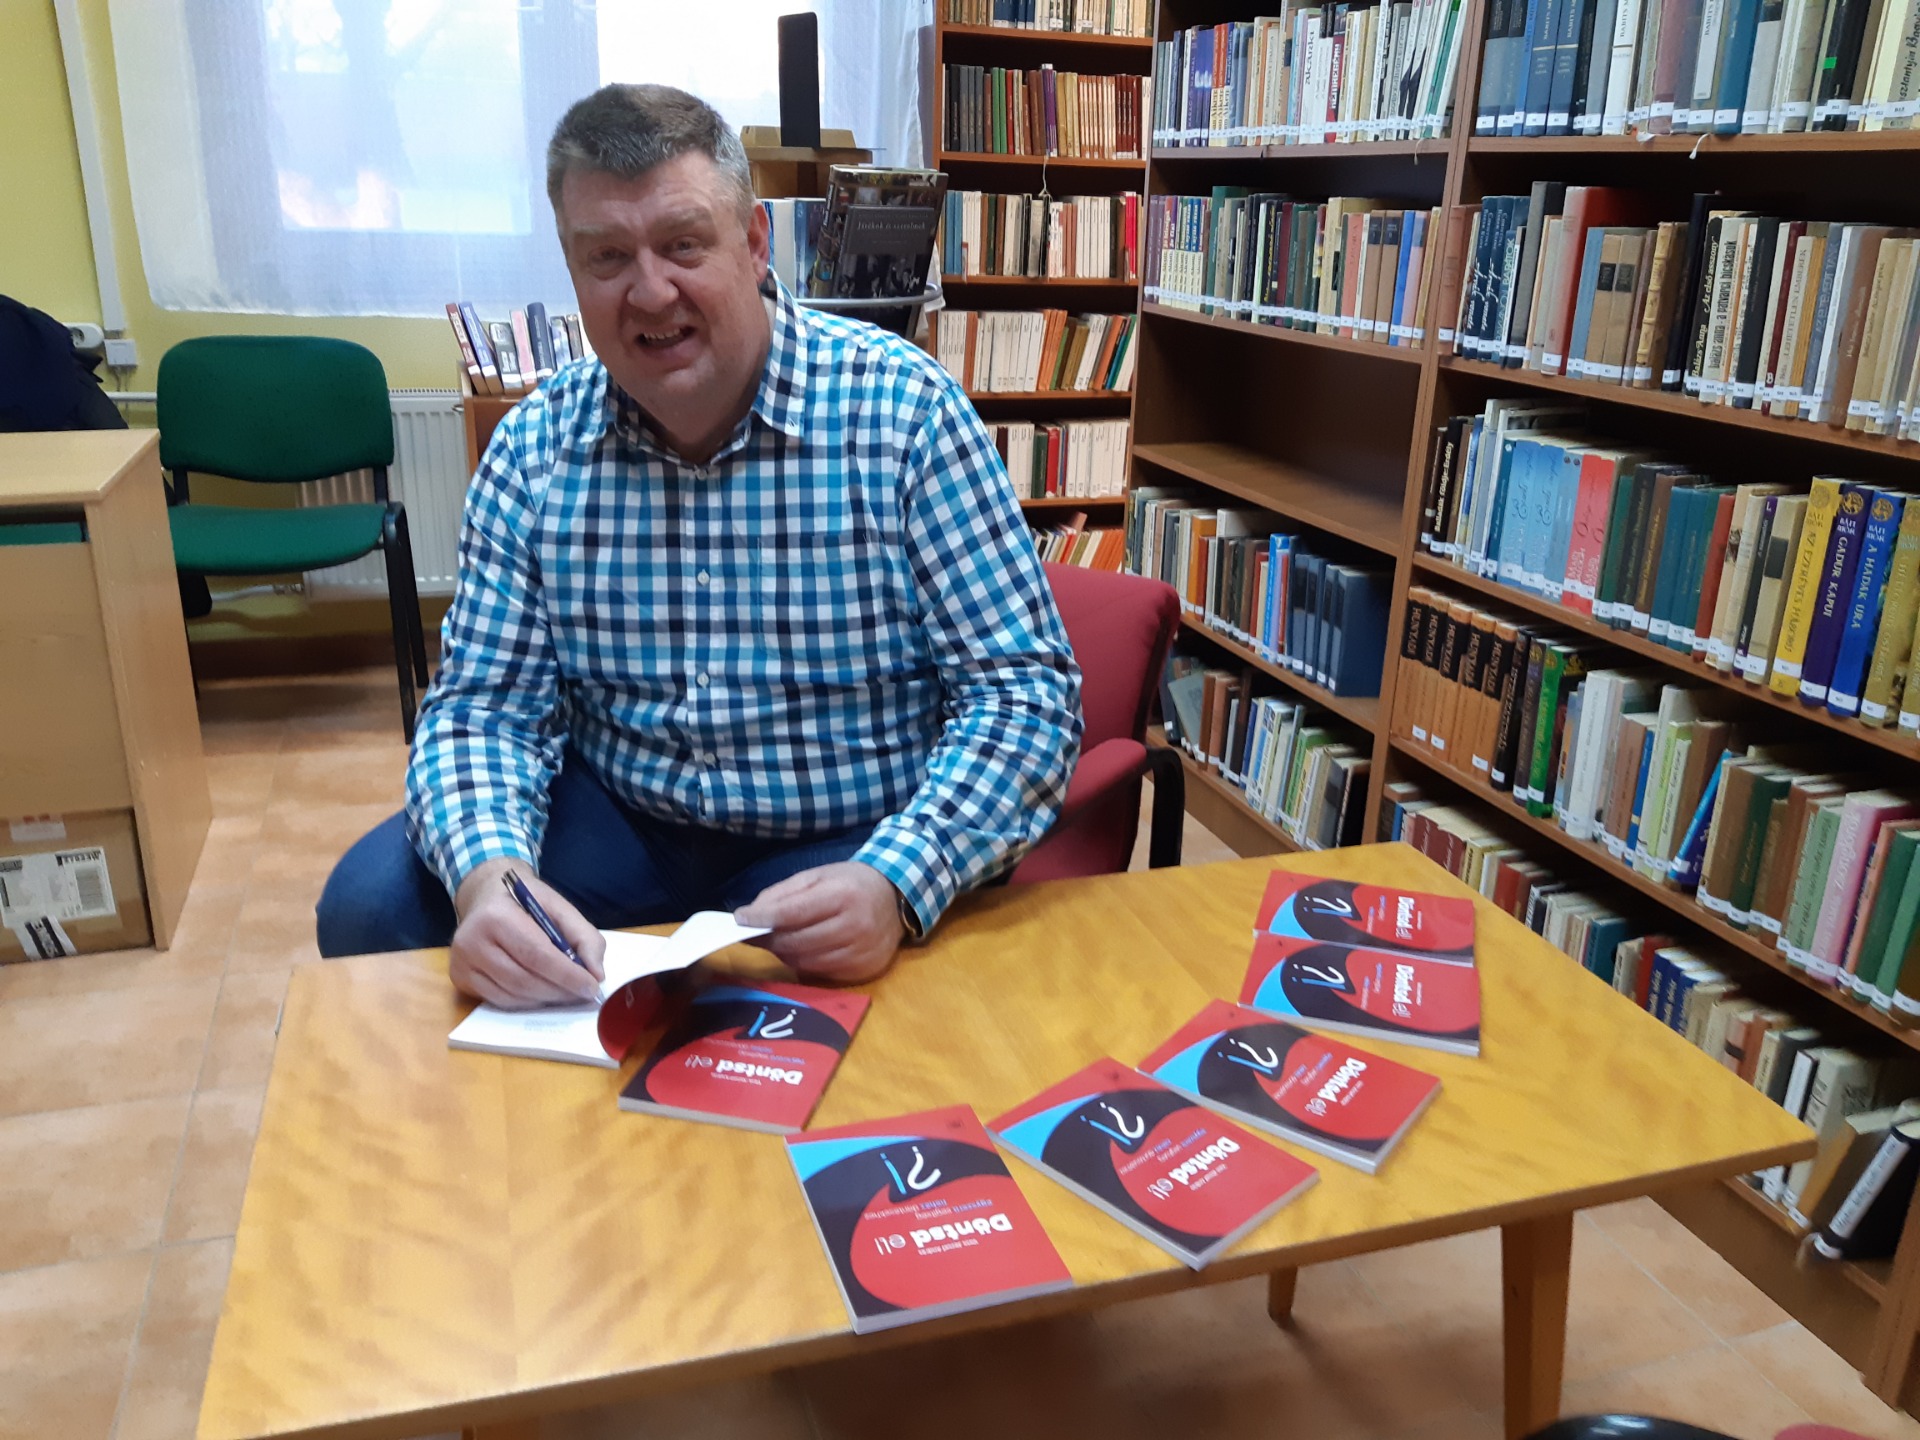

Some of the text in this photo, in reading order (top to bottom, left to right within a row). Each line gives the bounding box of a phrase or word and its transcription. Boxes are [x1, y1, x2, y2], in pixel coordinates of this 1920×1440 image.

[1707, 235, 1718, 275] asszony
[1696, 323, 1709, 348] Anna
[1691, 348, 1702, 376] Balázs
[1823, 582, 1837, 617] KAPUI
[1856, 557, 1876, 600] HADAK
[1407, 607, 1421, 655] HUNYADI
[1425, 614, 1438, 662] HUNYADI
[1851, 604, 1864, 628] URA
[1442, 623, 1455, 673] HUNYADI
[1466, 632, 1479, 683] HUNYADI
[1488, 641, 1501, 692] HUNYADI
[715, 1058, 803, 1085] Döntsd
[1316, 1055, 1367, 1101] Döntsd
[1167, 1134, 1240, 1186] Döntsd
[873, 1212, 1013, 1256] Döntsd el!
